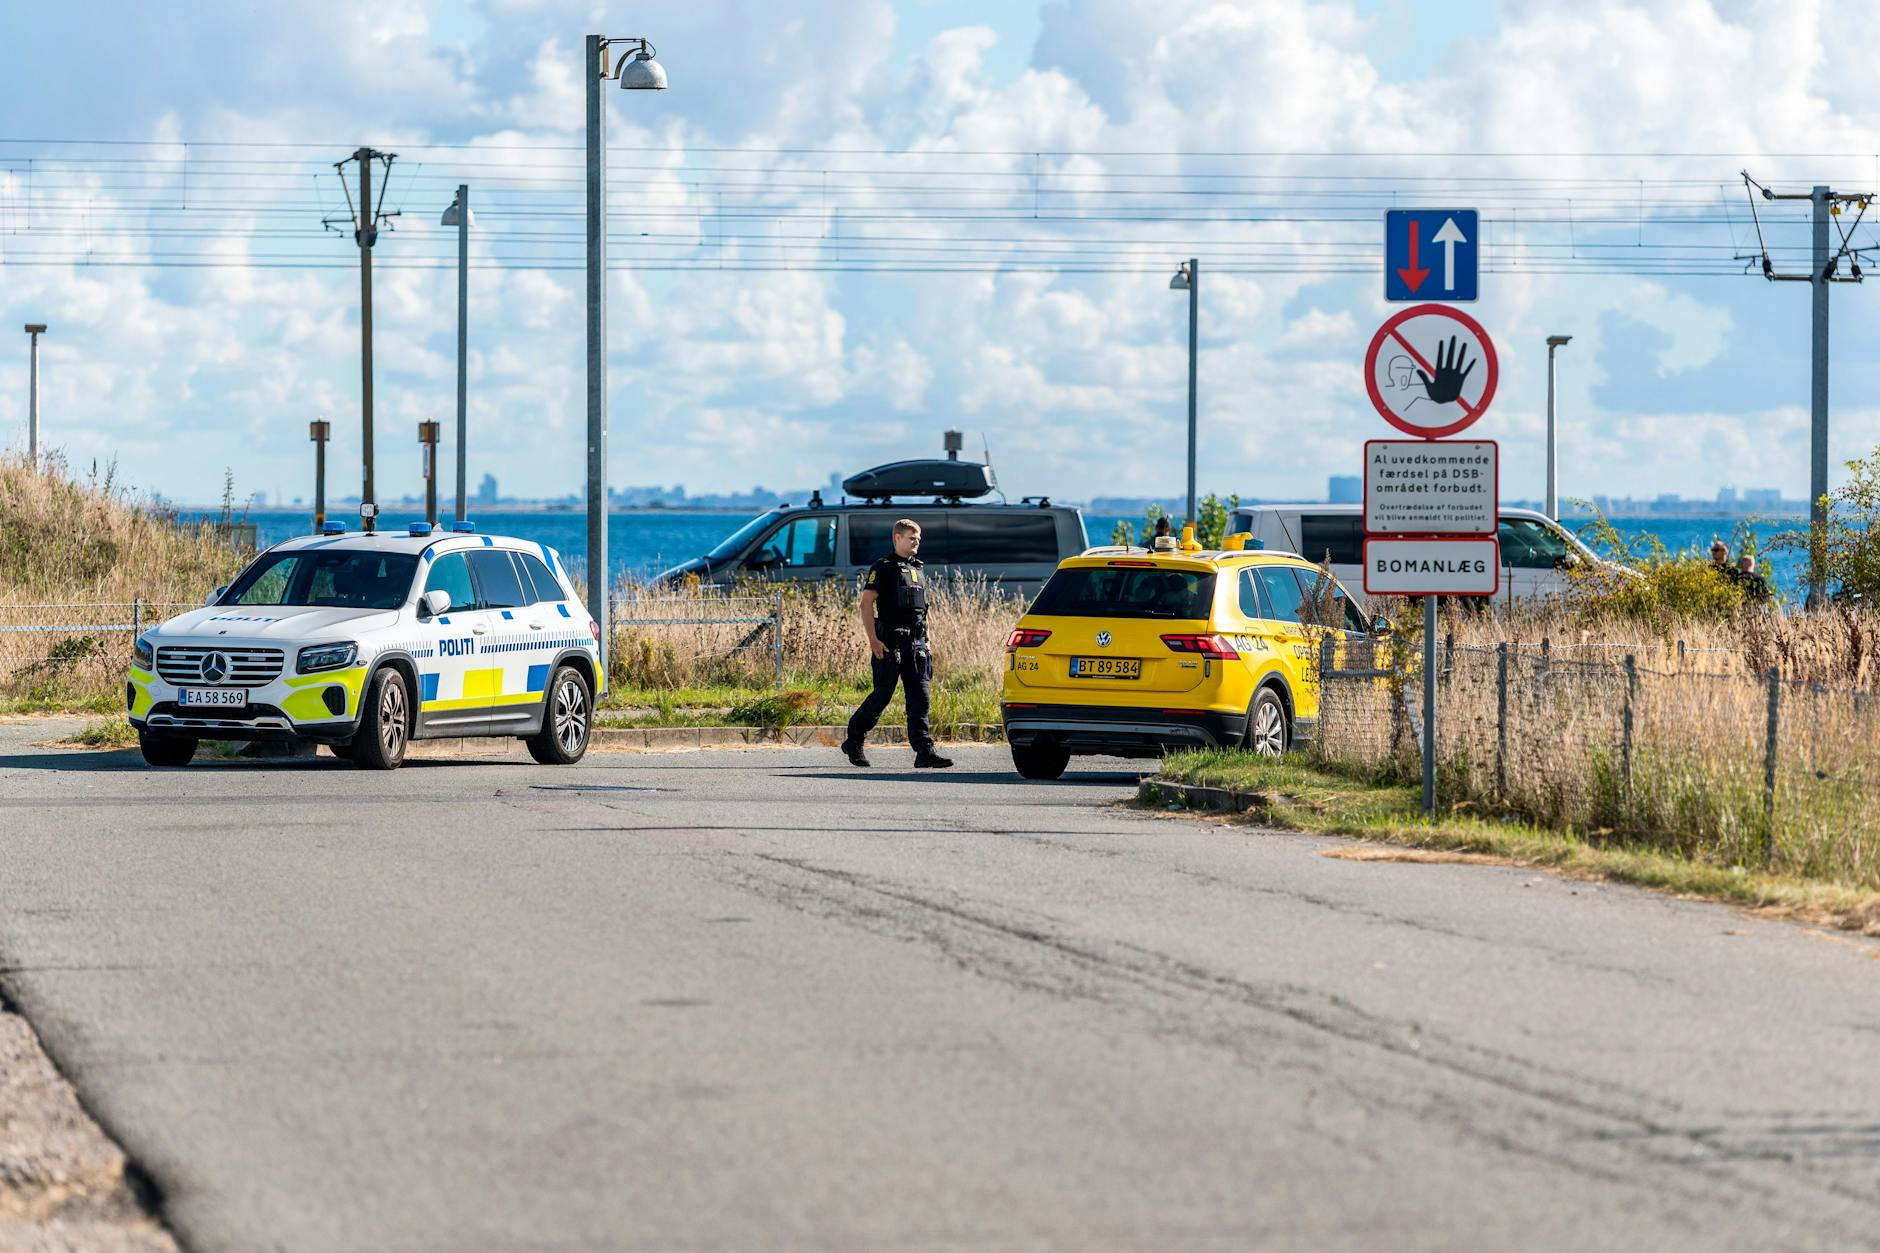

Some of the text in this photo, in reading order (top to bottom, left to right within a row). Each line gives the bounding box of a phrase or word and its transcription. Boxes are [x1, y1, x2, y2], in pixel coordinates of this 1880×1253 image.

[1374, 455, 1489, 464] Al uvedkommende
[1380, 469, 1485, 480] færdsel på DSB-
[1376, 483, 1487, 493] området forbudt.
[1380, 503, 1483, 511] Overtrædelse af forbudet
[1377, 560, 1486, 573] BOMANLÆG
[439, 637, 475, 657] POLITI
[1234, 634, 1269, 651] AG 24
[1018, 662, 1039, 671] AG 24
[1079, 660, 1137, 674] BT 89 584
[188, 691, 243, 704] EA 58 569
